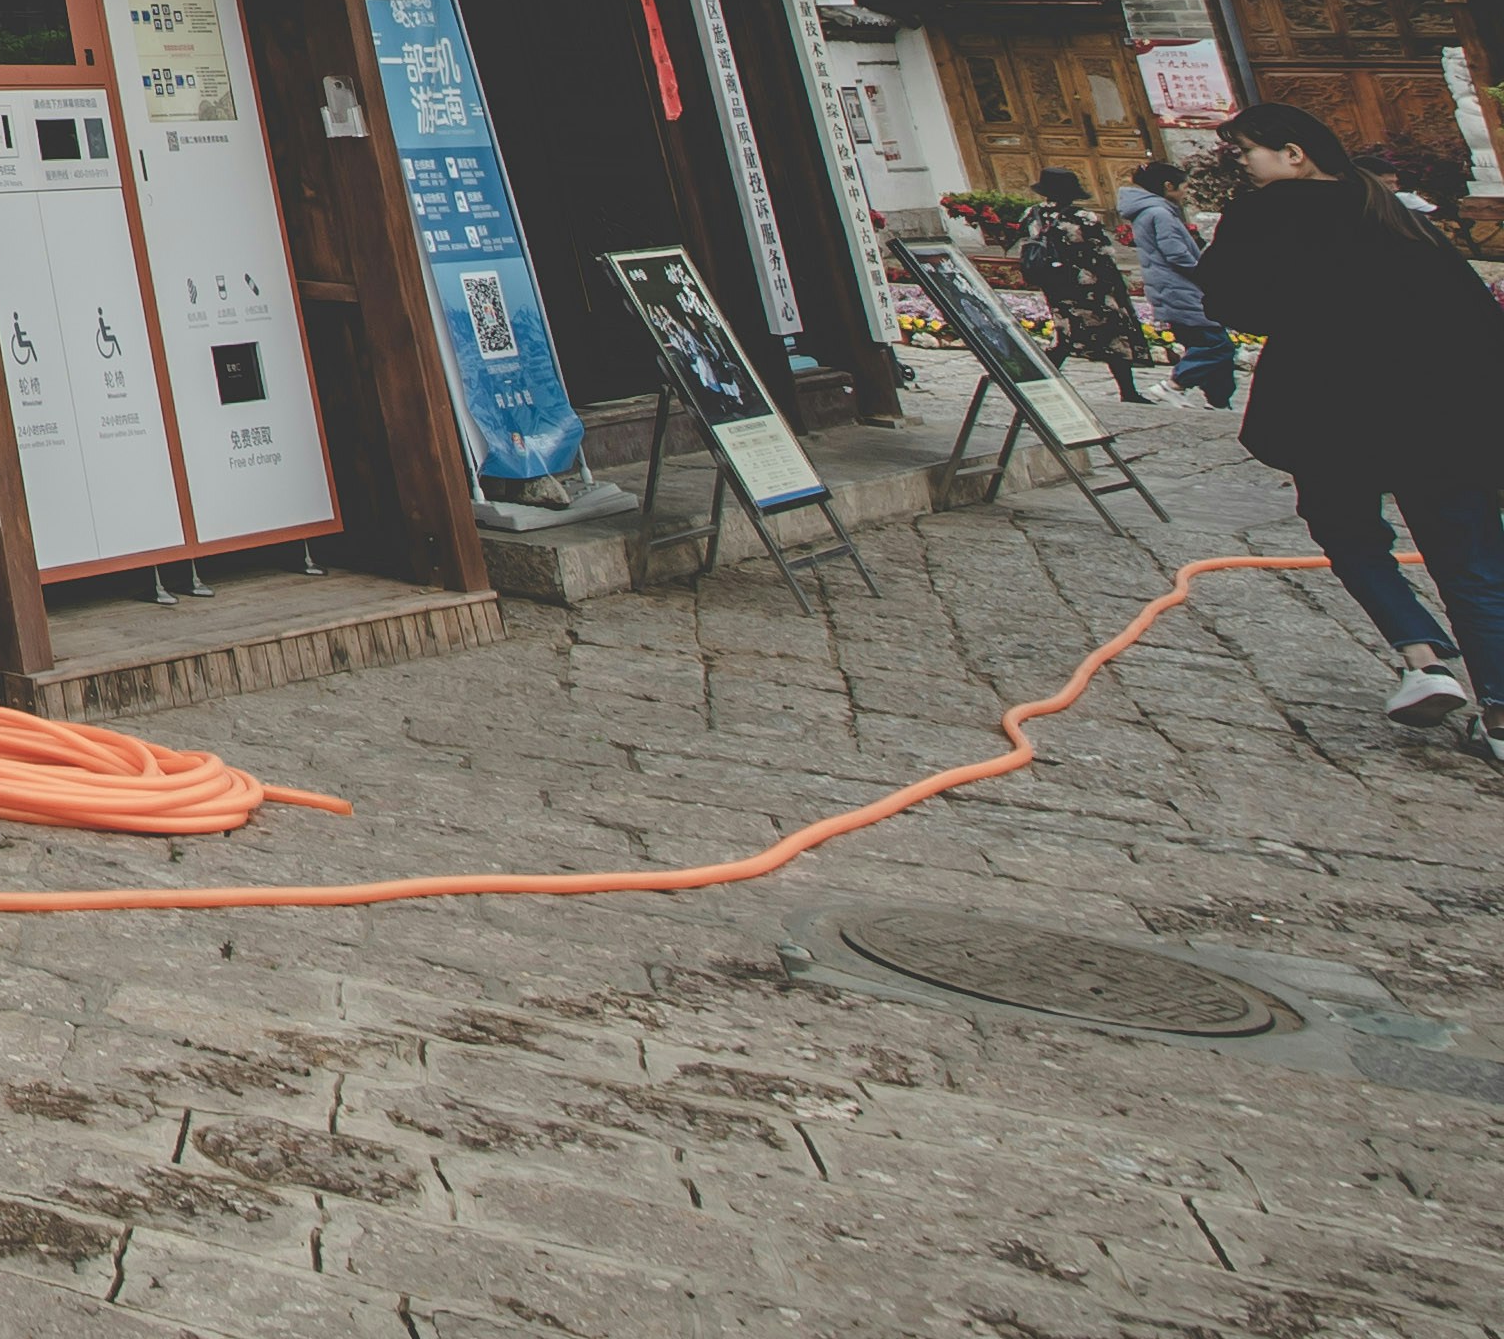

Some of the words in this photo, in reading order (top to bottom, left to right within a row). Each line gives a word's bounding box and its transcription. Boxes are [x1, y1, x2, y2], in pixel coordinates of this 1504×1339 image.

[18, 376, 42, 396] 轮椅
[102, 370, 126, 389] 轮椅
[230, 425, 273, 451] 免费领取
[229, 456, 246, 470] Free
[248, 454, 256, 466] of
[256, 452, 282, 468] charge
